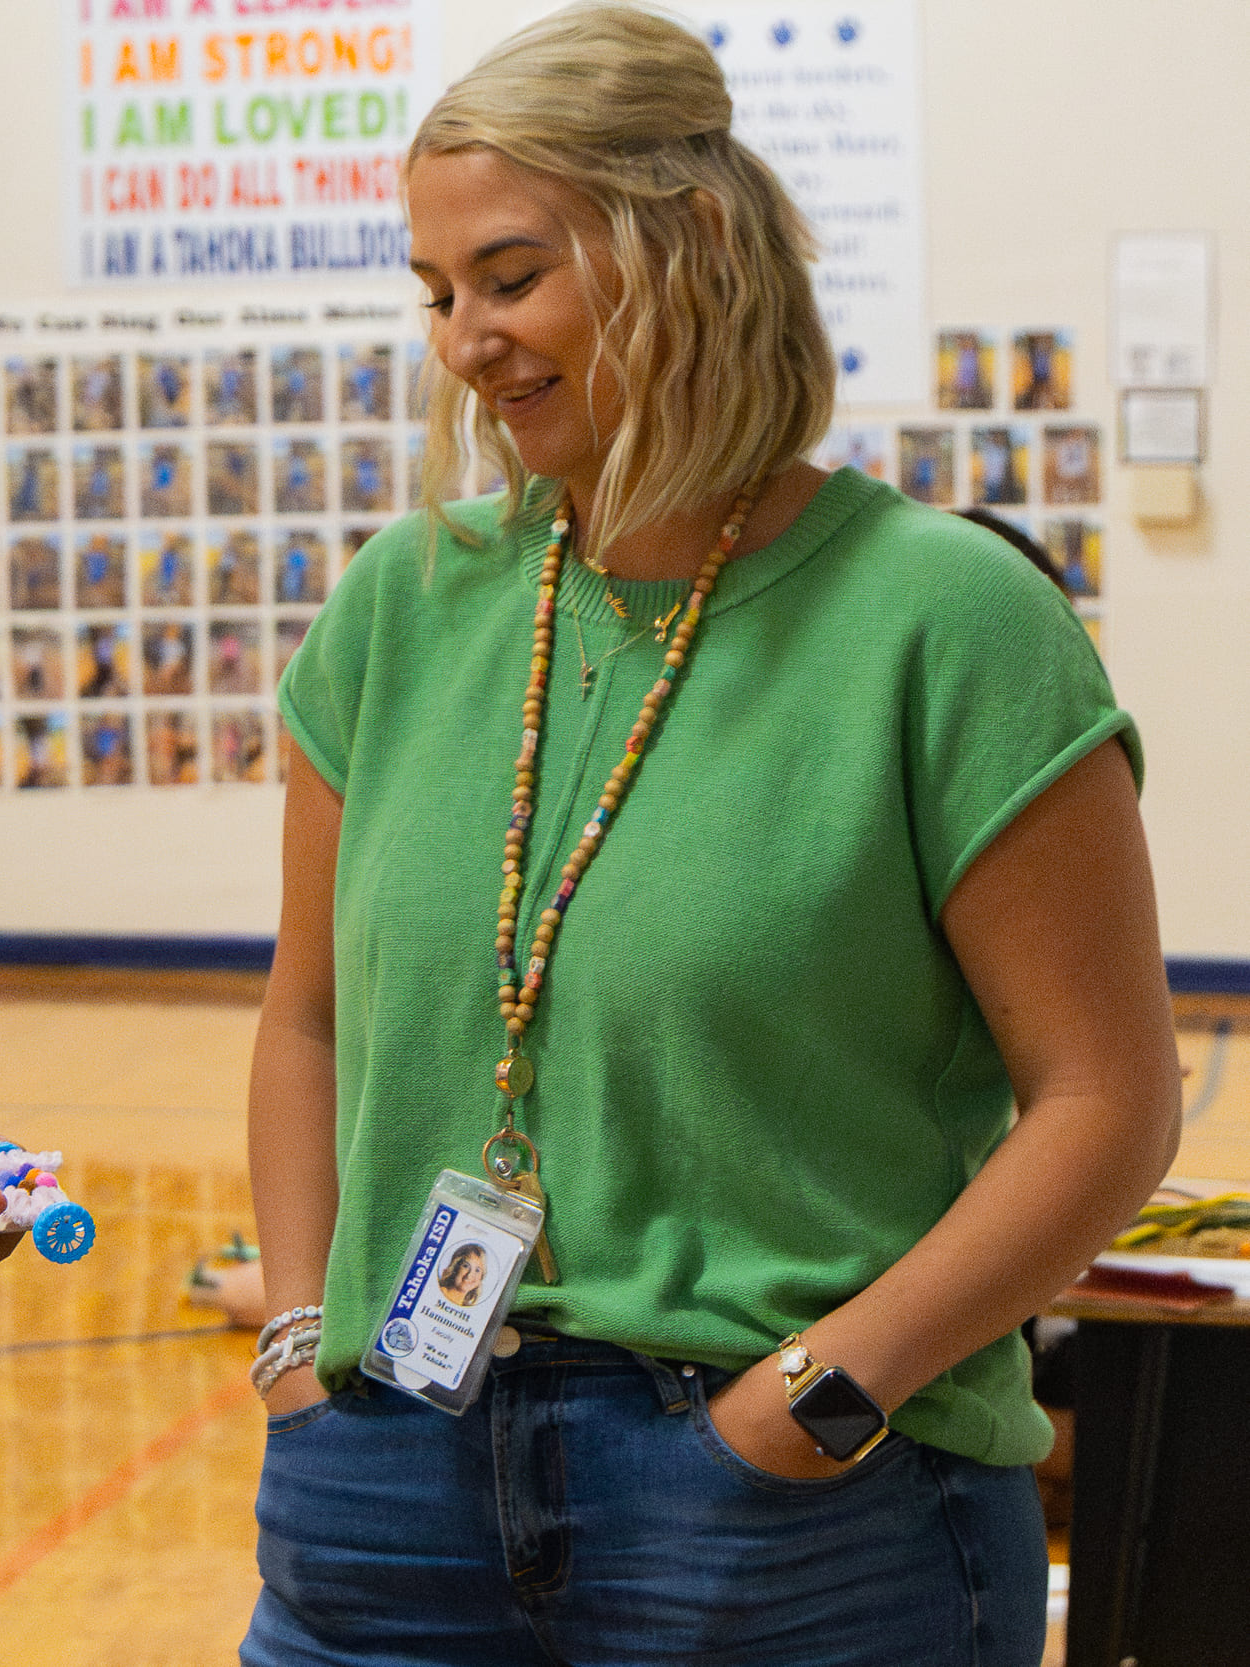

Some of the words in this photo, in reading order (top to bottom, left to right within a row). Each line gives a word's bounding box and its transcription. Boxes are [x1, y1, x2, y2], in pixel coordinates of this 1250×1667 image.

[80, 38, 93, 87] I
[114, 35, 181, 84] AM
[203, 25, 412, 82] STRONG!
[81, 102, 95, 151] I
[117, 97, 191, 147] AM
[215, 86, 408, 145] LOVED!
[81, 164, 94, 214] I
[102, 164, 164, 213] CAN
[175, 161, 217, 210] DO
[227, 158, 285, 207] ALL
[398, 1246, 437, 1309] Tahoka
[433, 1210, 452, 1242] ISD
[420, 1305, 475, 1338] Hammonds
[436, 1299, 471, 1322] Merritt
